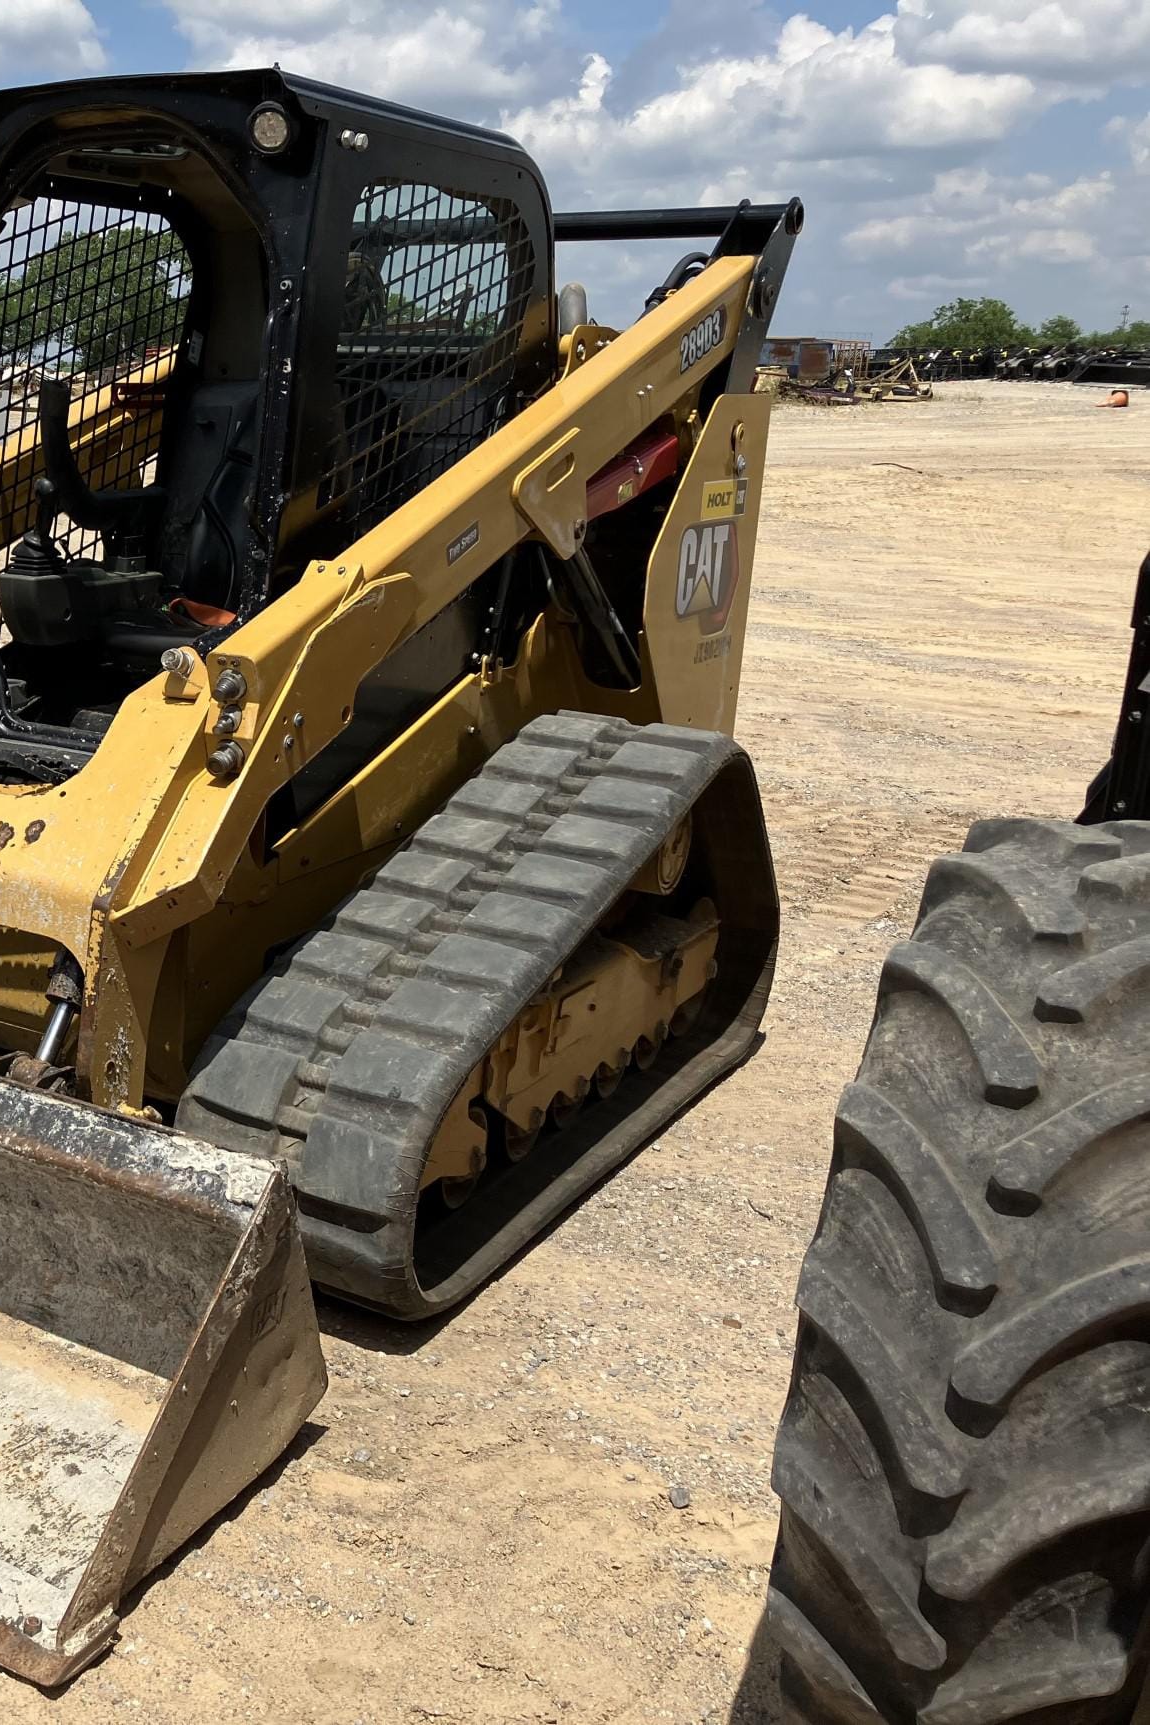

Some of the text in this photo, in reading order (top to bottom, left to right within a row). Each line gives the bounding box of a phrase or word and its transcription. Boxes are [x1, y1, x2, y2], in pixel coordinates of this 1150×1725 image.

[680, 309, 722, 374] 289D3
[706, 490, 734, 509] HOLT
[675, 523, 731, 617] CAT
